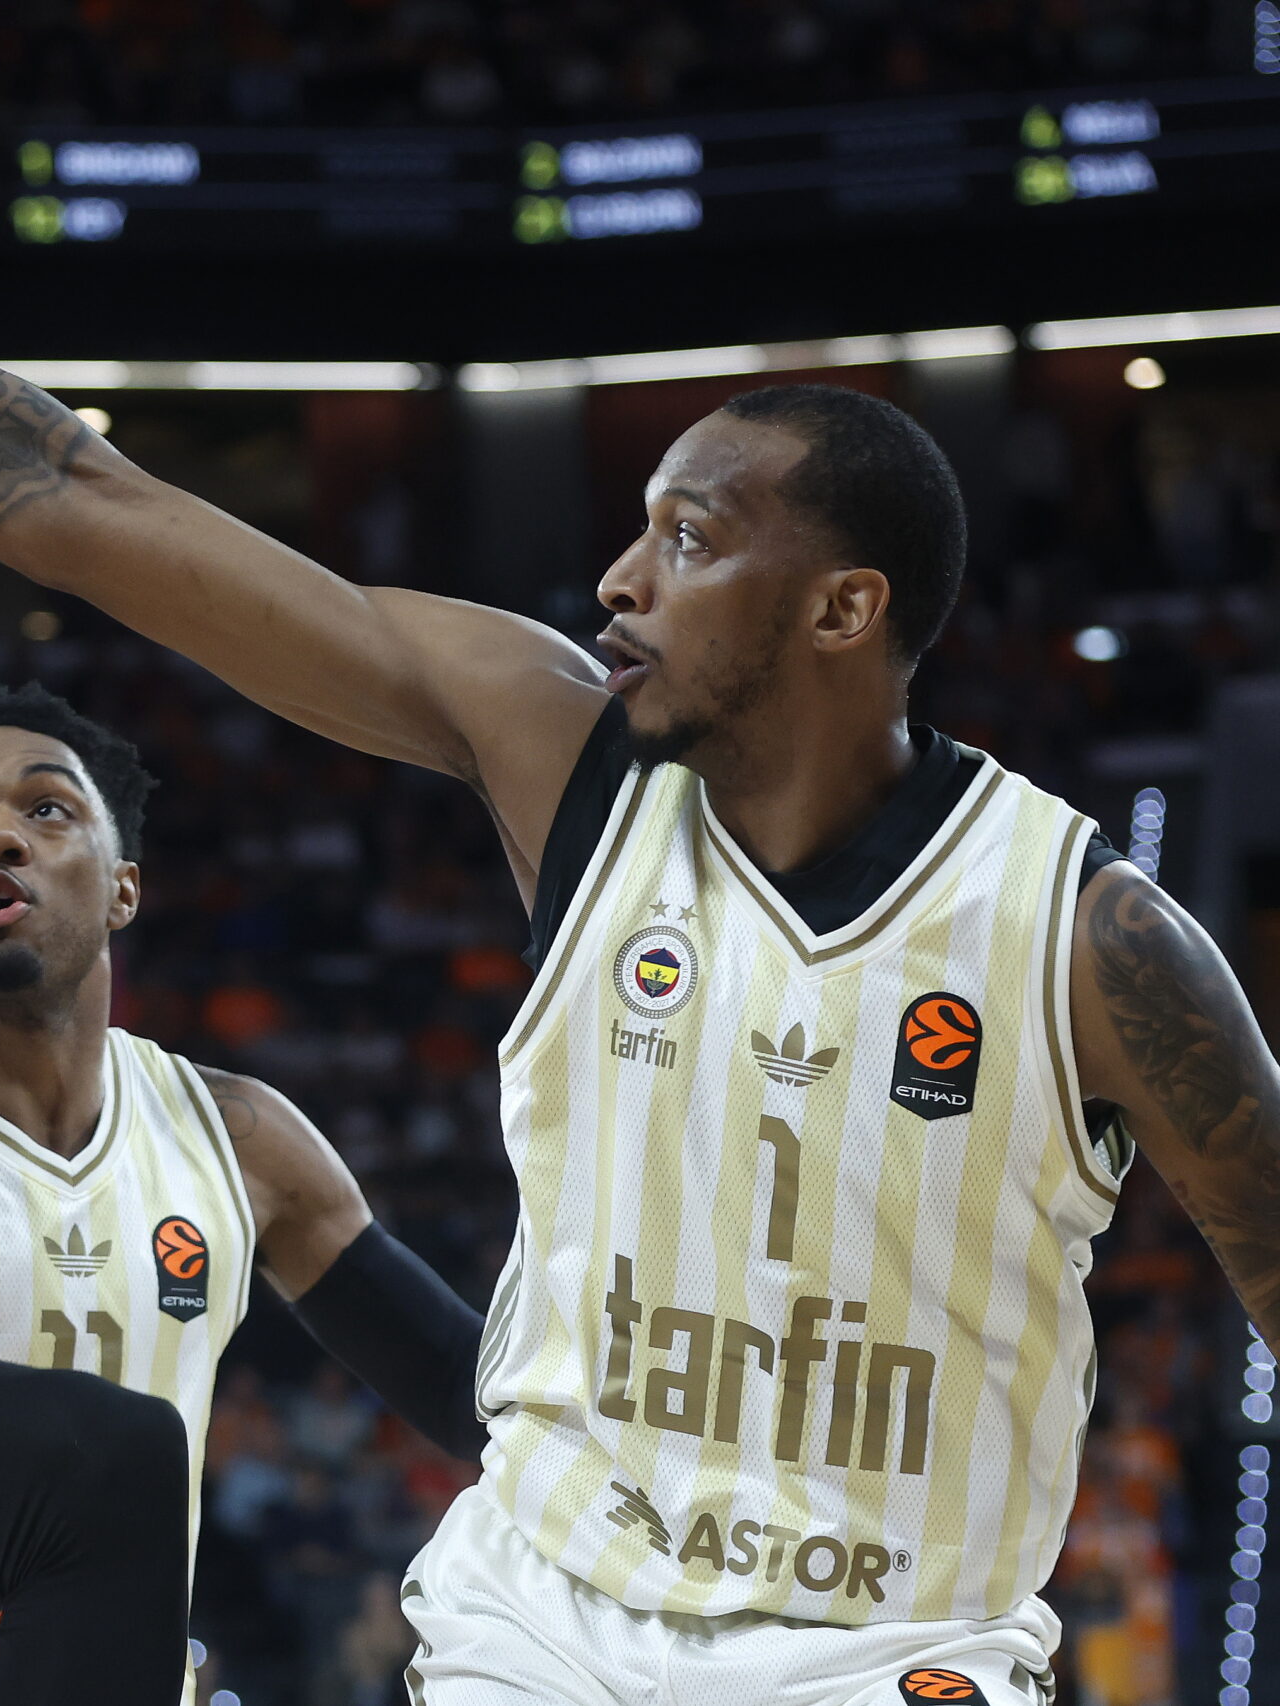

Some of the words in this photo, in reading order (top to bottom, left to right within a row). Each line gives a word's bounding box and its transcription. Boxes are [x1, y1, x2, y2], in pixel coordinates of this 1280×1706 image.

[611, 1019, 677, 1069] tarfin
[896, 1085, 967, 1106] ETIHAD
[758, 1113, 801, 1262] 1
[161, 1295, 206, 1308] ETIHAD
[598, 1253, 936, 1475] tarfin
